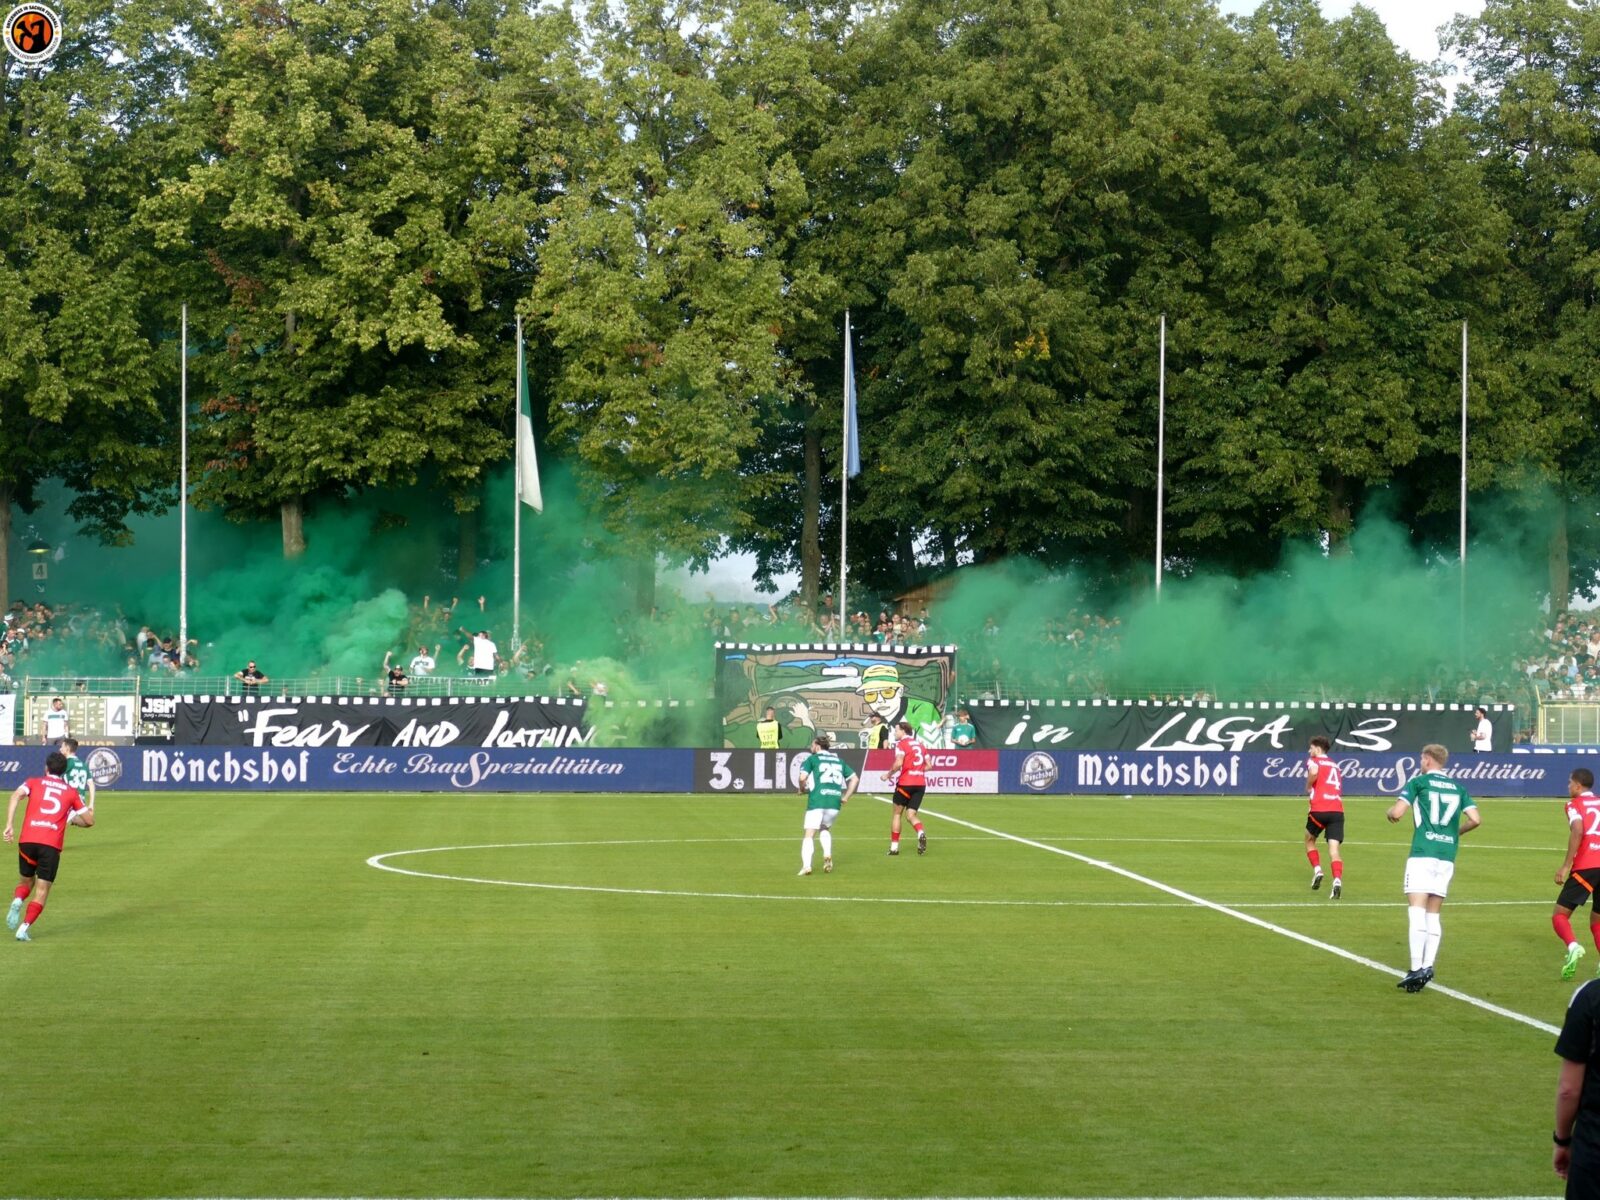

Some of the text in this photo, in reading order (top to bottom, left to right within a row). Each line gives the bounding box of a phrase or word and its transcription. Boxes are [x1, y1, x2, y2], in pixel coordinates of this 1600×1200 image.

[35, 564, 43, 580] 4
[111, 705, 128, 730] 4
[392, 718, 460, 748] AND
[481, 710, 626, 748] LOATHIN
[1005, 711, 1398, 752] in LIGA 3
[142, 749, 310, 784] Mönchshof
[333, 751, 626, 788] Echte BrauSpezialitäten
[708, 752, 745, 789] 3.
[911, 746, 923, 766] 3
[1078, 753, 1240, 788] Mönchshof
[69, 769, 87, 789] 33
[819, 762, 843, 786] 25
[888, 776, 973, 788] SWETTEN
[1326, 767, 1341, 791] 4
[1336, 756, 1545, 793] BrauSpialitäten
[40, 786, 62, 814] 5
[1428, 790, 1460, 827] 17
